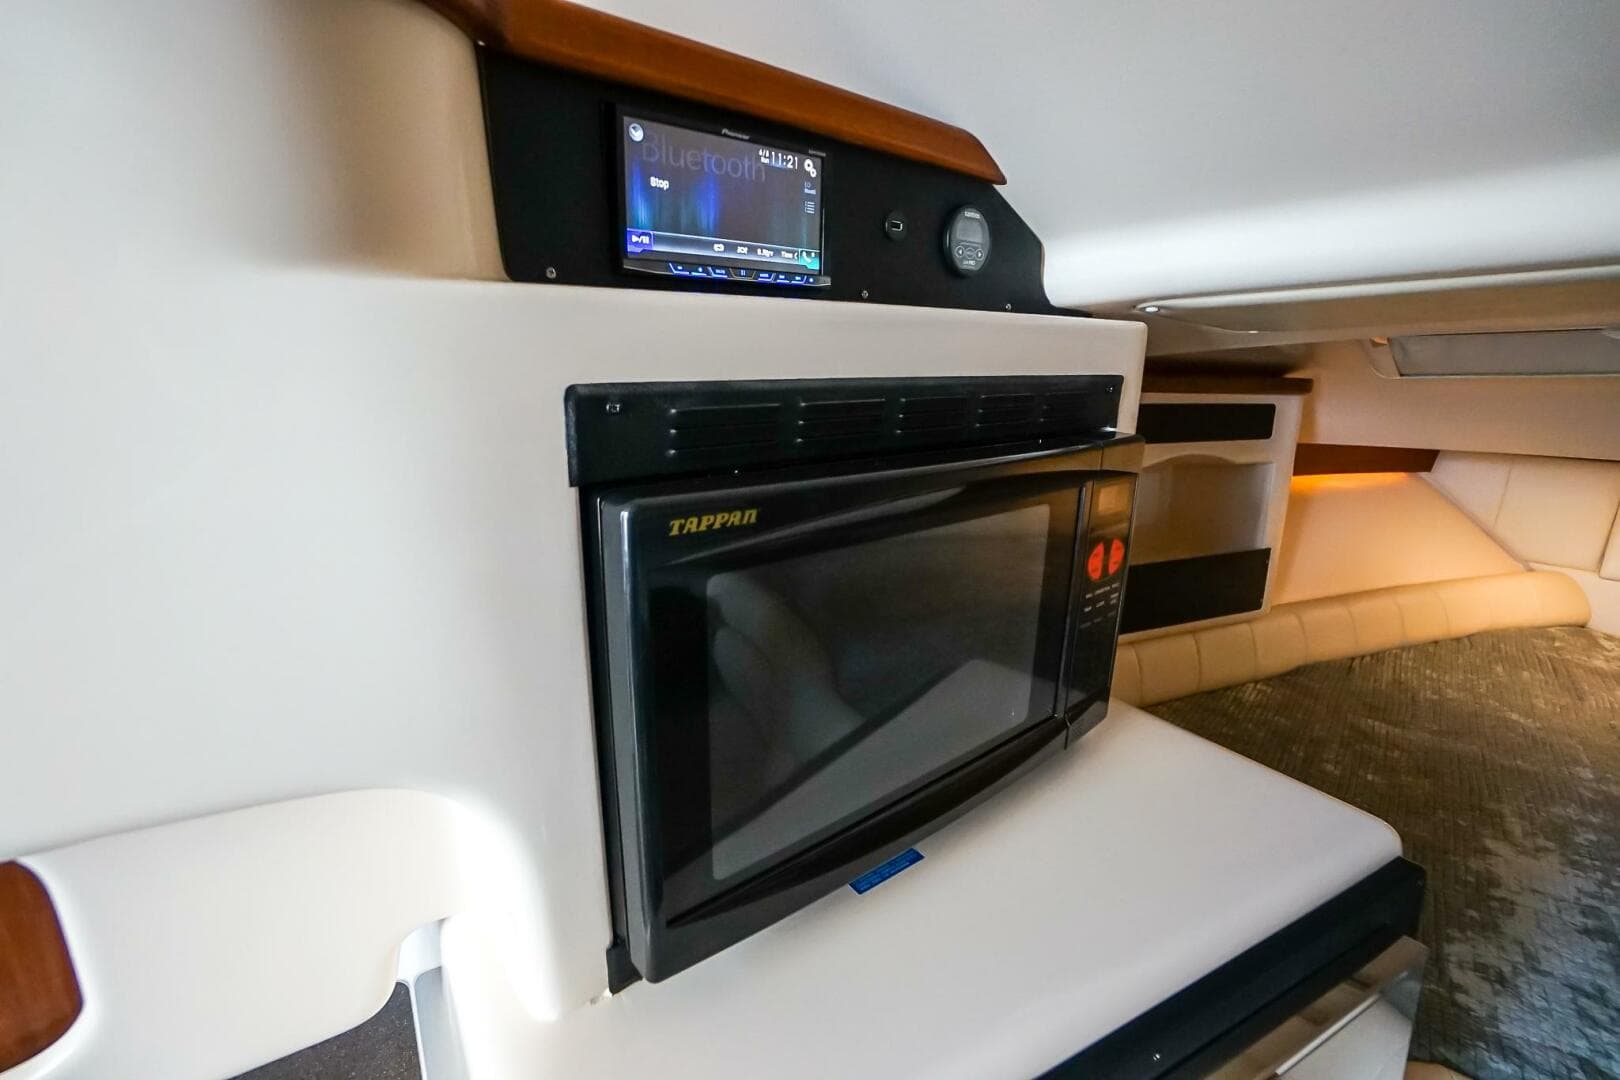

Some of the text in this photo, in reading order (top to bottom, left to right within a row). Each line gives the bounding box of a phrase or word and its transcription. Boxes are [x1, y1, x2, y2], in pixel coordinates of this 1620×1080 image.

[643, 131, 766, 182] Bluetooth
[771, 151, 798, 170] 11:21
[650, 176, 670, 191] Stop
[669, 508, 758, 536] TAPPAN
